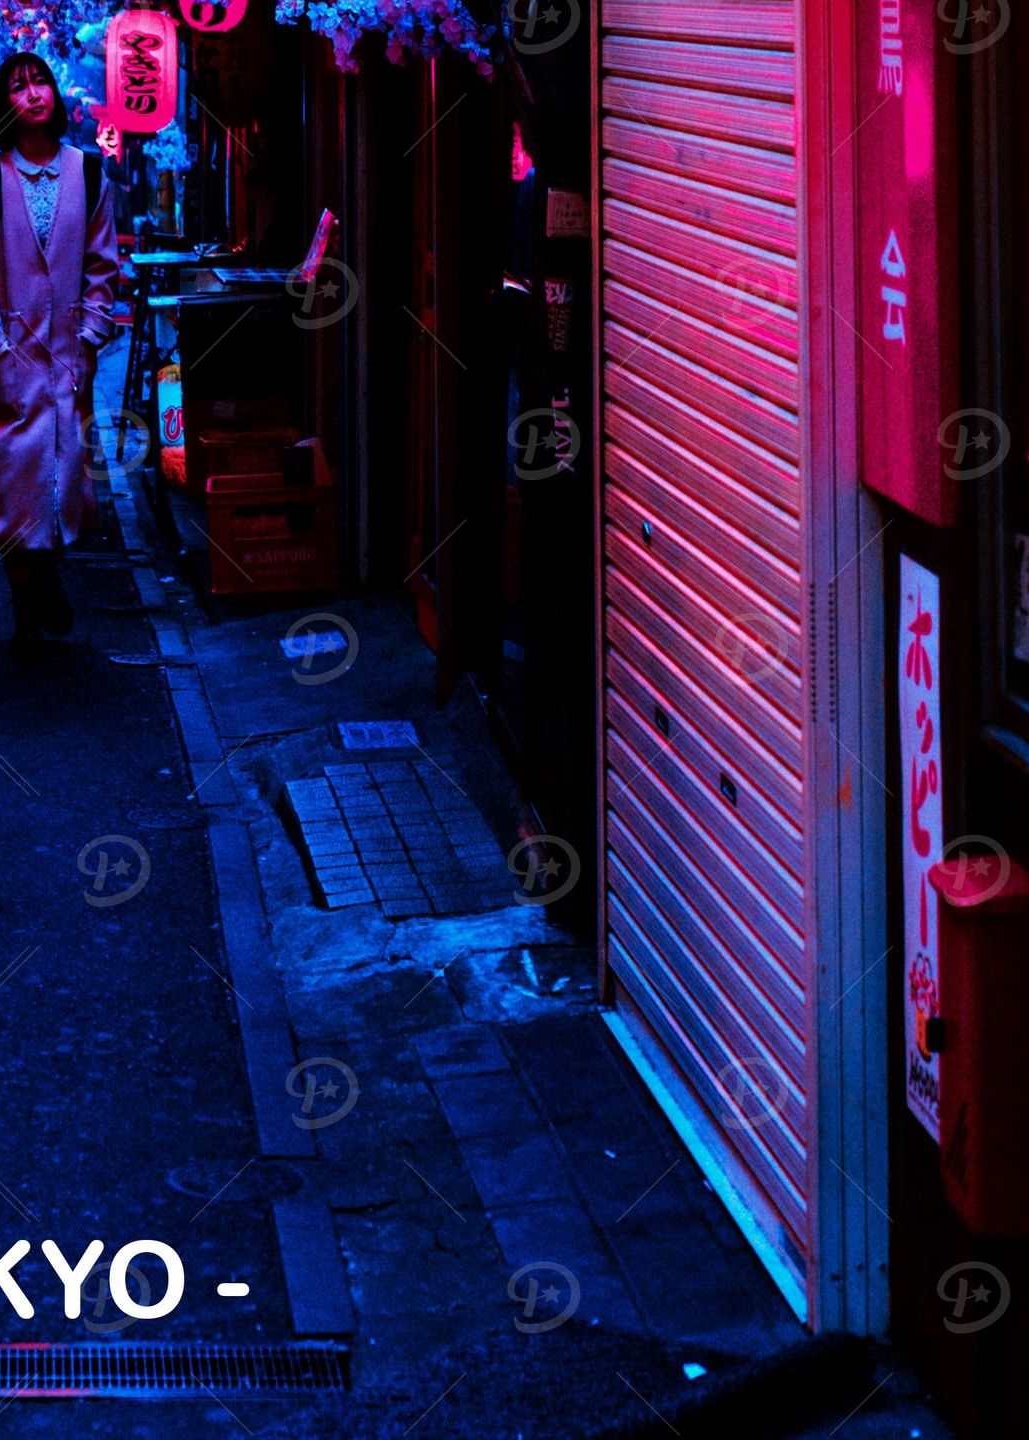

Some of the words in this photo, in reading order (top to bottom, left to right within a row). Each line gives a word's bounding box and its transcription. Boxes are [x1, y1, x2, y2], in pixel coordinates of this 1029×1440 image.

[122, 33, 162, 115] やきとり
[905, 582, 939, 948] ホッピー
